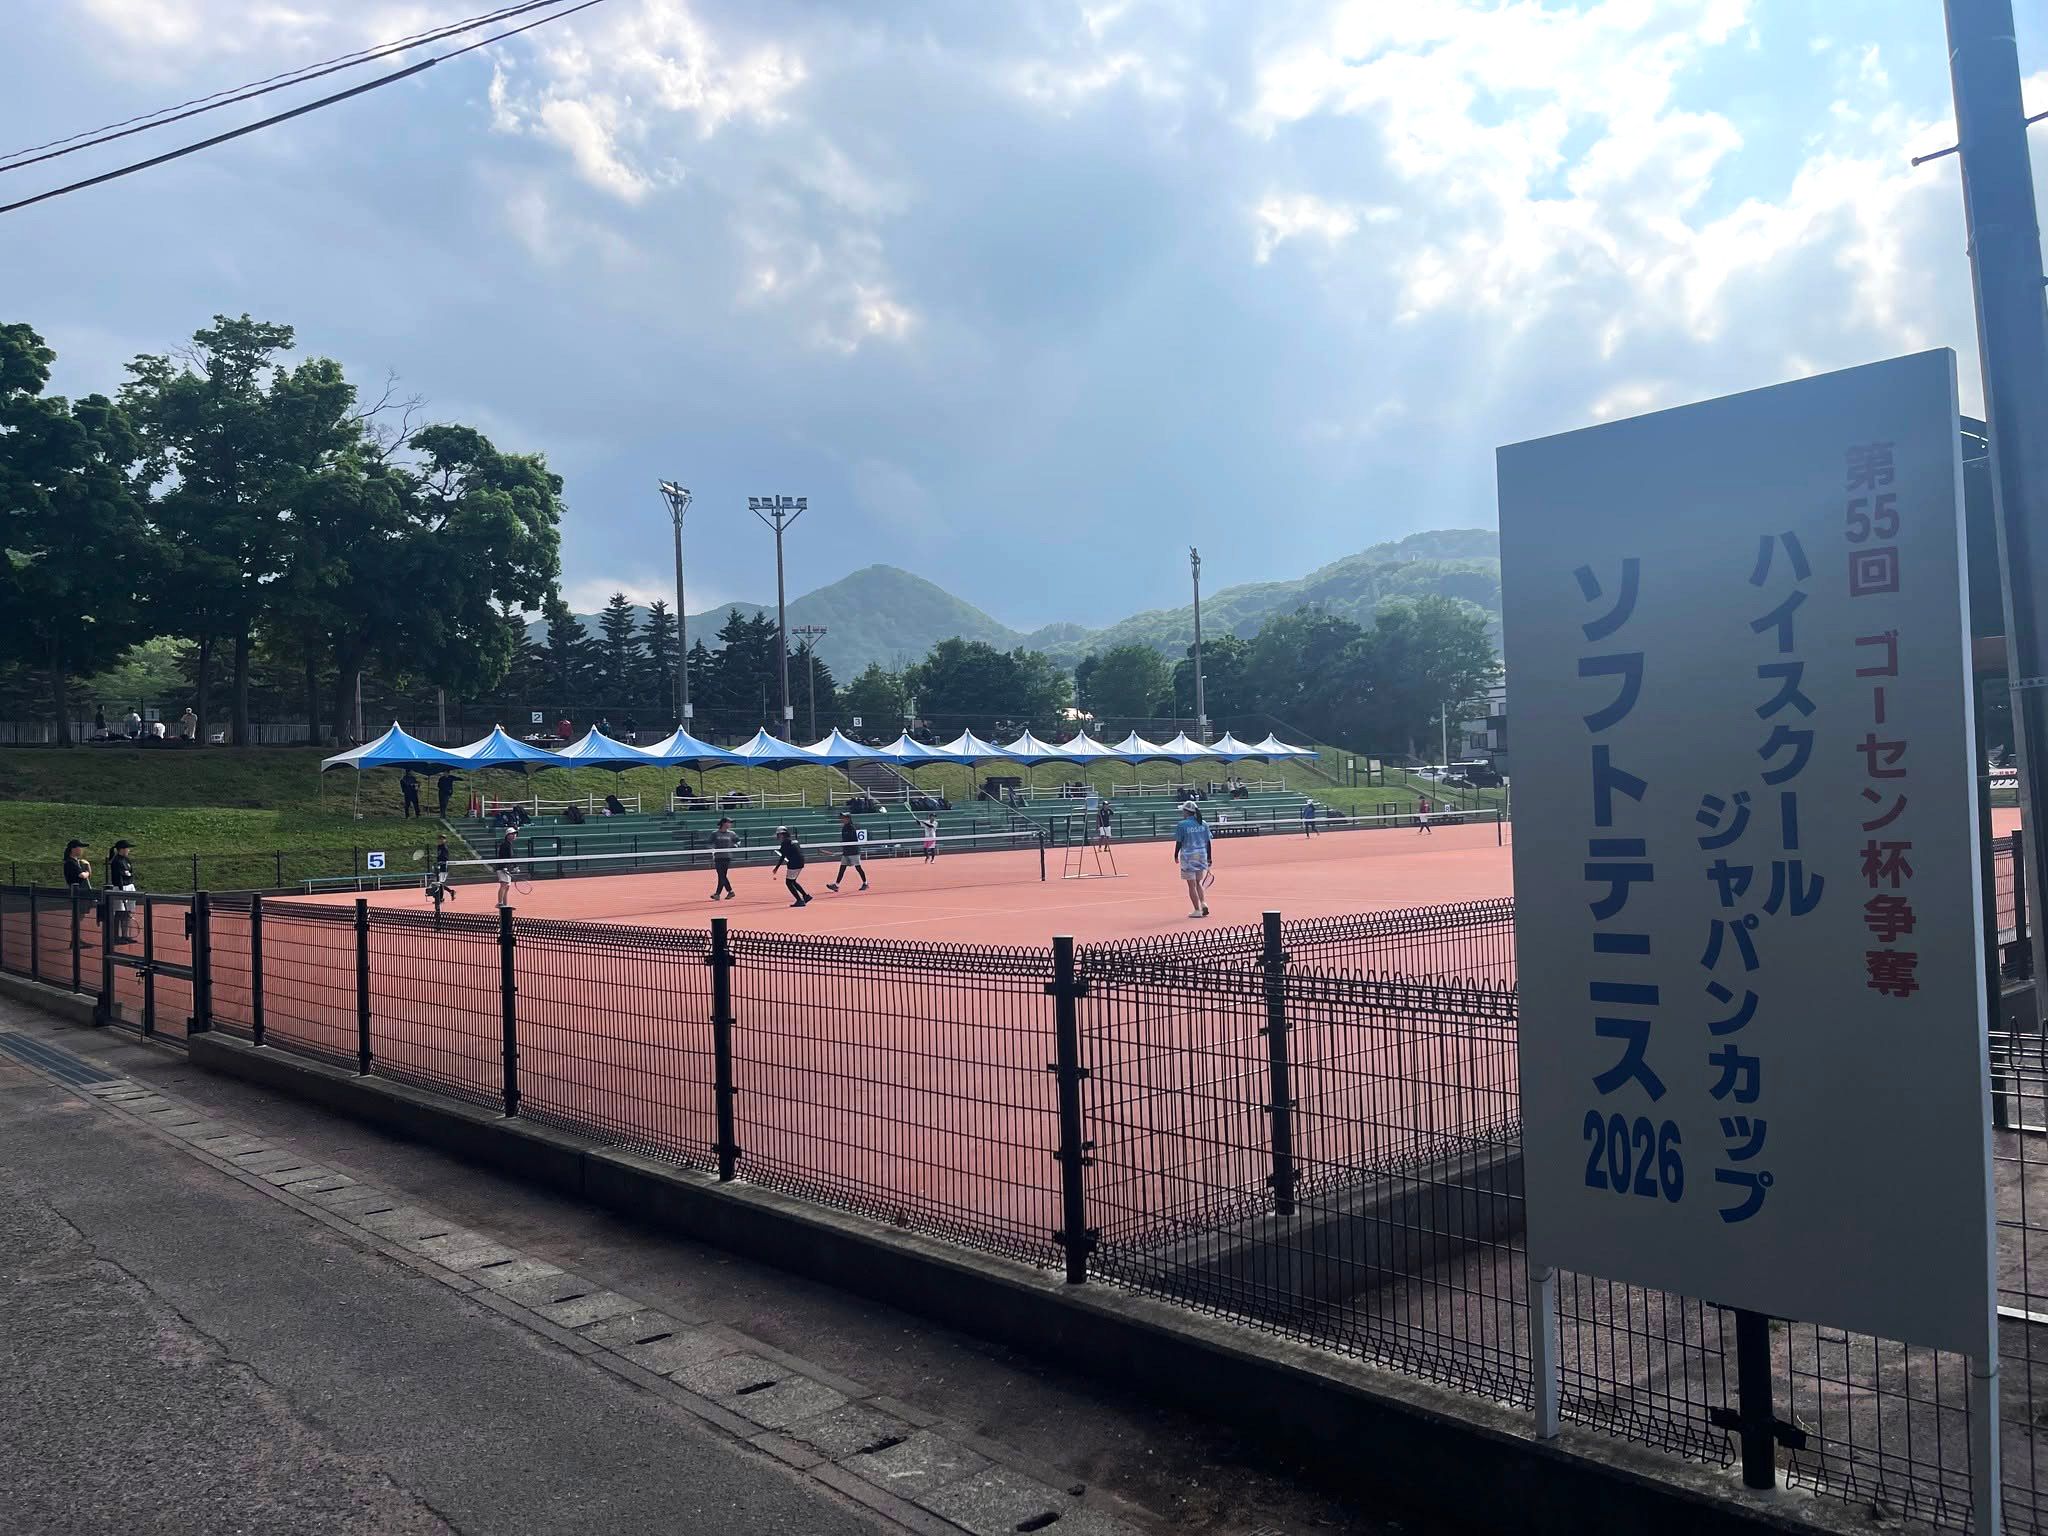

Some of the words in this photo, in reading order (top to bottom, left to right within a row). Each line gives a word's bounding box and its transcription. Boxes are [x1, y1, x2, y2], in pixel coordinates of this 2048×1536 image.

[1845, 441, 1900, 597] 第55回
[857, 831, 865, 841] 6
[1573, 558, 1667, 1102] ソフトテニス
[1749, 531, 1825, 917] ハイスクール
[1855, 629, 1920, 998] ゴーセン杯争奪
[369, 854, 384, 868] 5
[1696, 791, 1774, 1223] ジャパンカップ
[1583, 1110, 1684, 1203] 2026
